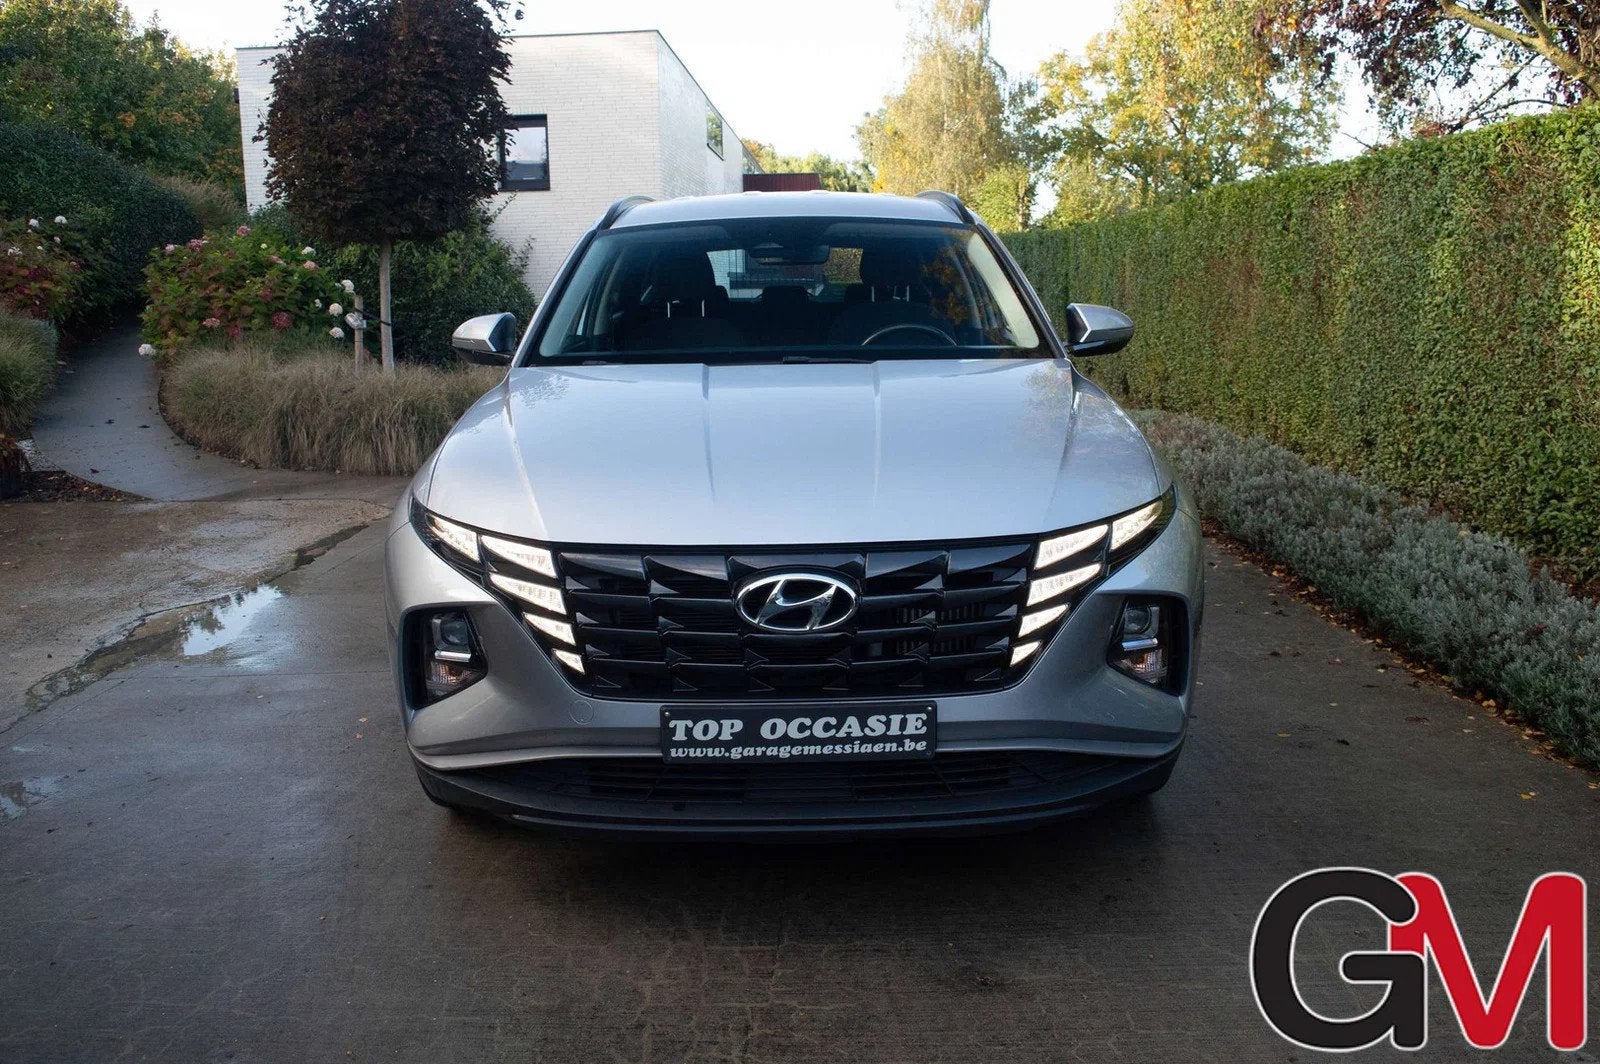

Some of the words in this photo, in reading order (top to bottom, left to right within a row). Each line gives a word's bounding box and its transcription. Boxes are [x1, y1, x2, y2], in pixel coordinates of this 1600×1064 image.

[669, 719, 743, 741] TOP
[760, 713, 927, 739] OCCASIE
[670, 739, 927, 759] www.garagemessiaen.be
